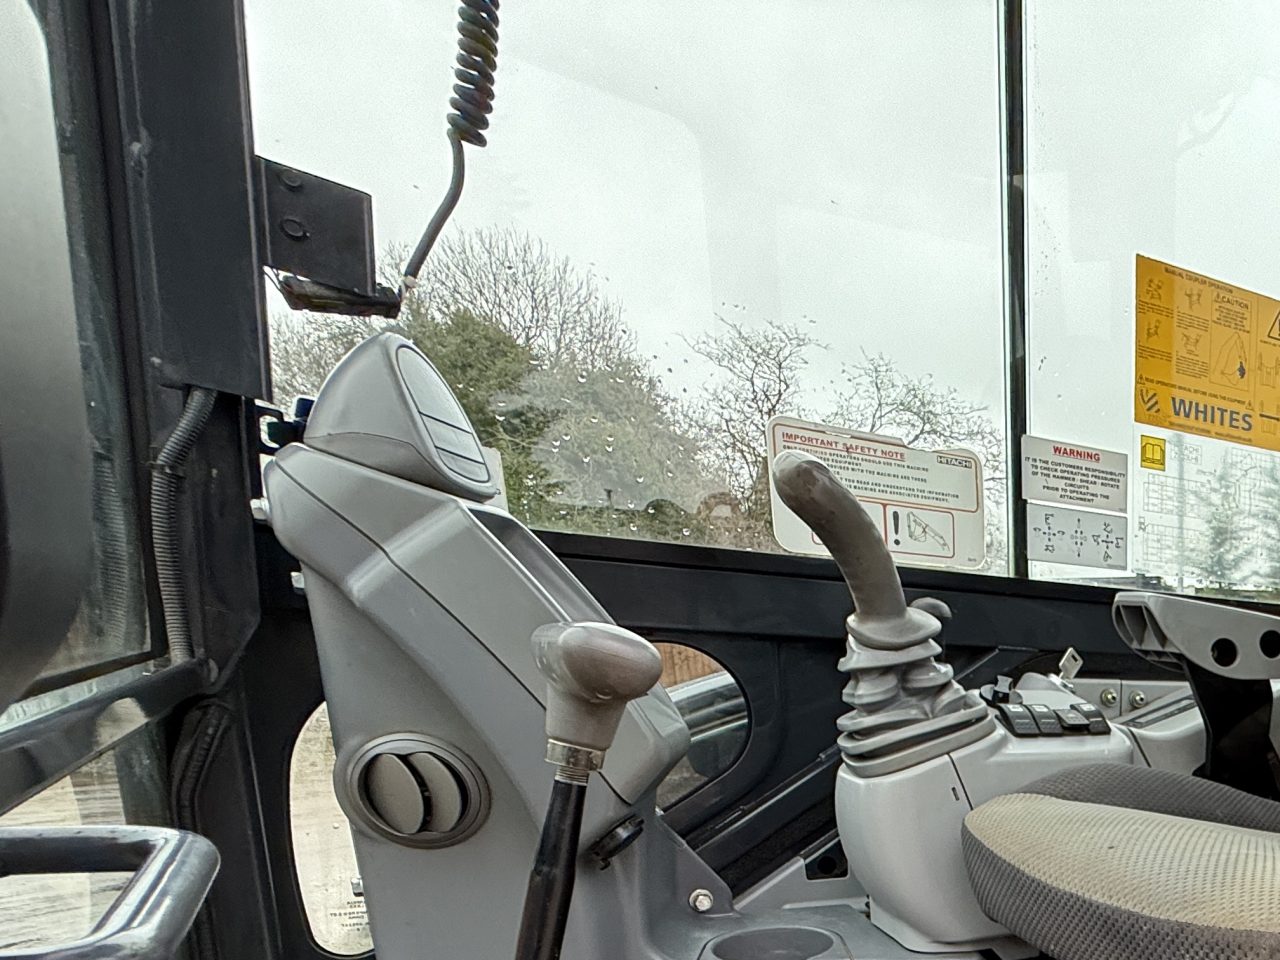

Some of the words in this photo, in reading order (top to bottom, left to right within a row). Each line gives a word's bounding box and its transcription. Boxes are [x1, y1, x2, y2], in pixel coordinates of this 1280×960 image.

[1222, 296, 1248, 310] CAUTION
[1171, 396, 1252, 431] WHITES
[782, 432, 838, 448] IMPORTANT
[842, 442, 878, 455] SAFETY
[881, 449, 905, 459] NOTE
[1053, 446, 1100, 461] WARNING
[937, 456, 972, 468] HITACHI
[1051, 460, 1084, 471] CUSTOMERS
[1085, 466, 1126, 478] RESPONSIBILITY
[1060, 469, 1089, 478] OPERATING
[1091, 474, 1120, 483] PRESSURES
[1064, 482, 1089, 490] CIRCUITS
[1060, 494, 1094, 503] ATTACHMENT
[1069, 489, 1098, 498] OPERATING
